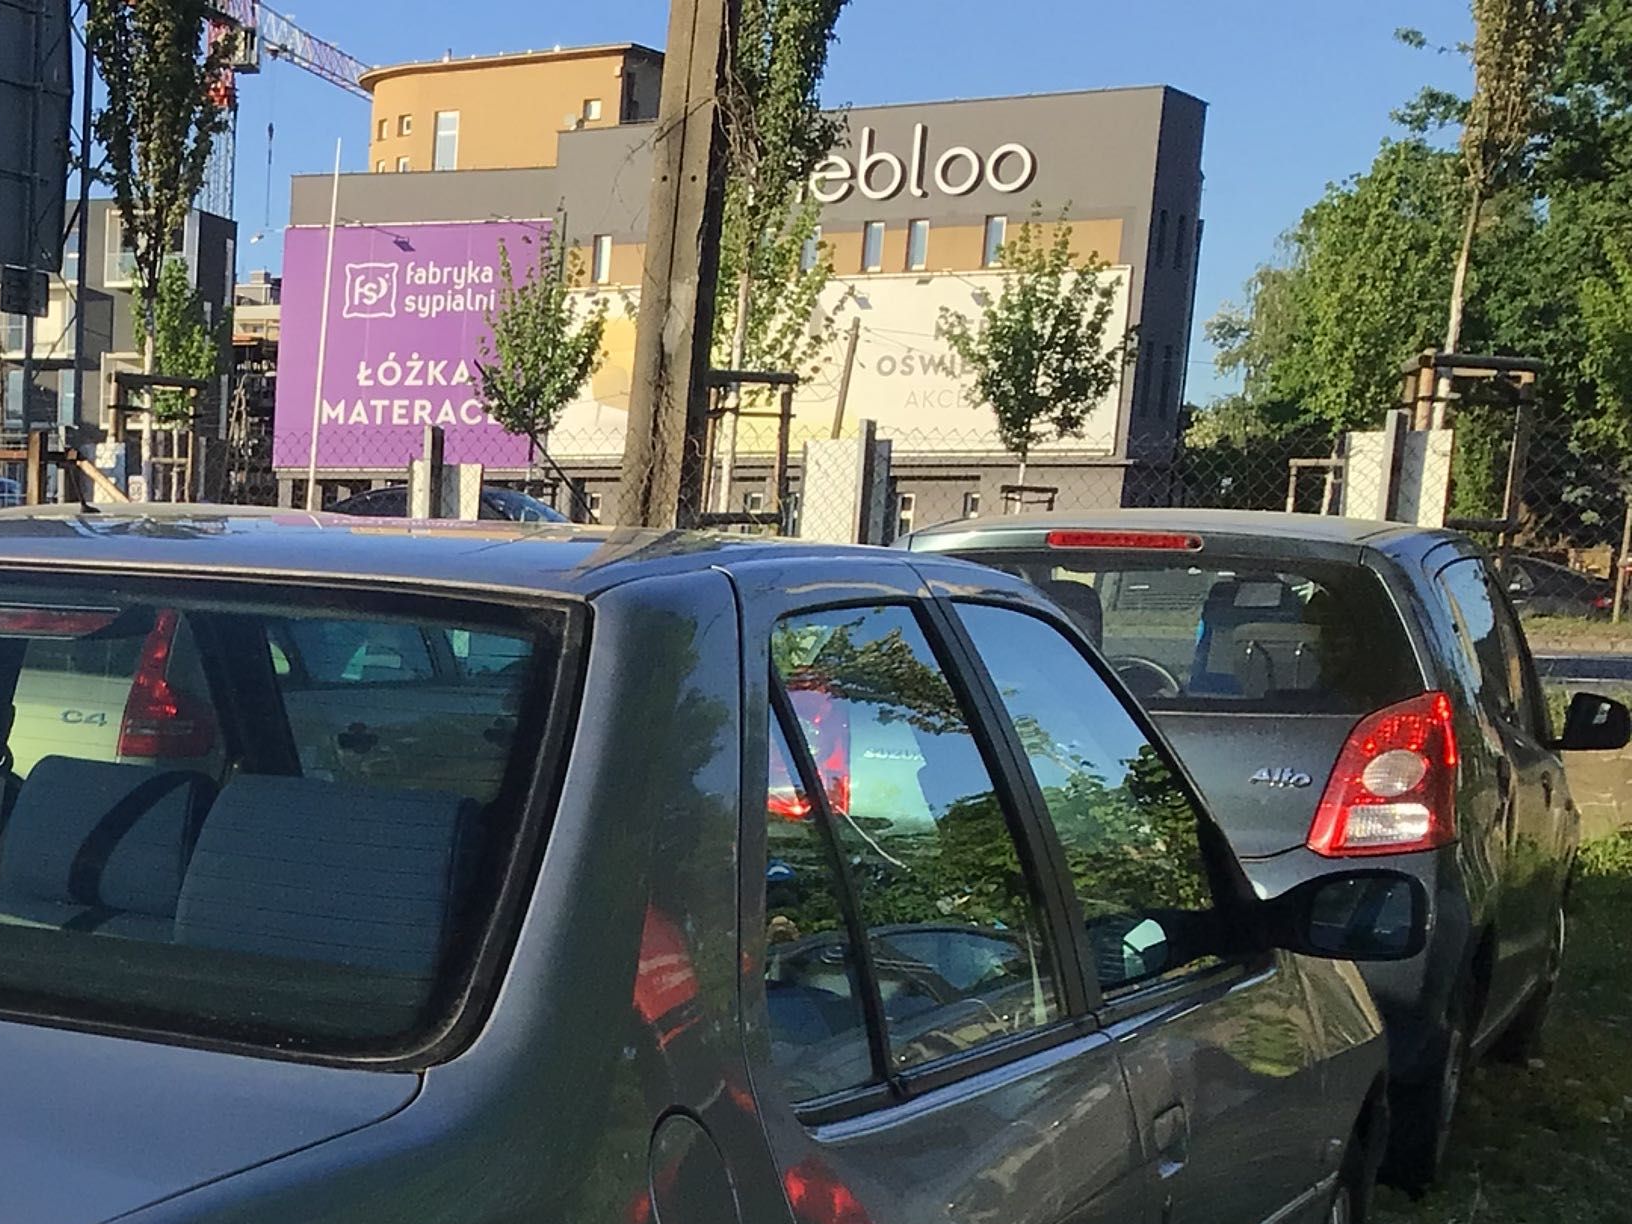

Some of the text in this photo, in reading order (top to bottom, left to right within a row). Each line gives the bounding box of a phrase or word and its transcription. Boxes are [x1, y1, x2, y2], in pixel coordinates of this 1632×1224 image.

[794, 122, 1036, 203] ebloo
[405, 260, 494, 290] fabryka
[404, 288, 496, 318] sypialni
[356, 352, 476, 387] ŁÓŻKA
[61, 709, 108, 727] C4
[1248, 767, 1314, 790] Alto
